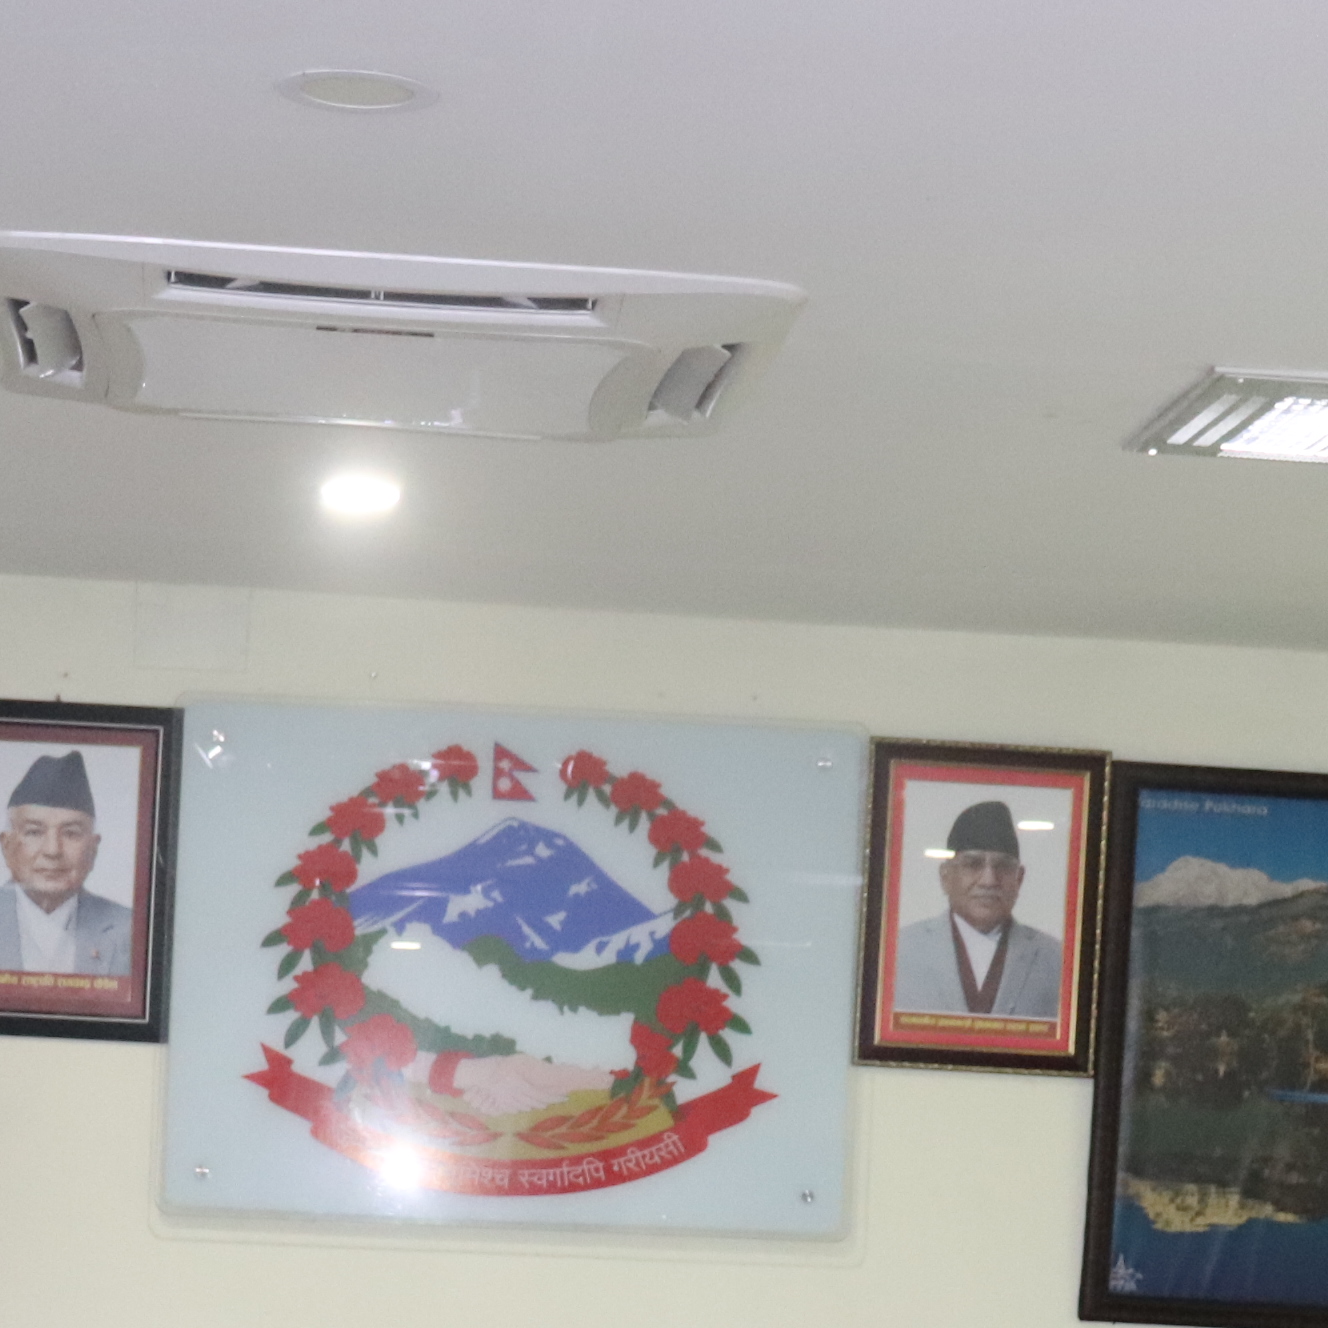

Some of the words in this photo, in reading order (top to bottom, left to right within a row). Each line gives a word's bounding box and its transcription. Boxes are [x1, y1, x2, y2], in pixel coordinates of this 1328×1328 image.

[1204, 800, 1269, 815] Pokhara
[518, 1157, 606, 1189] स्वर्गादपि
[611, 1132, 686, 1175] गरीयसी
